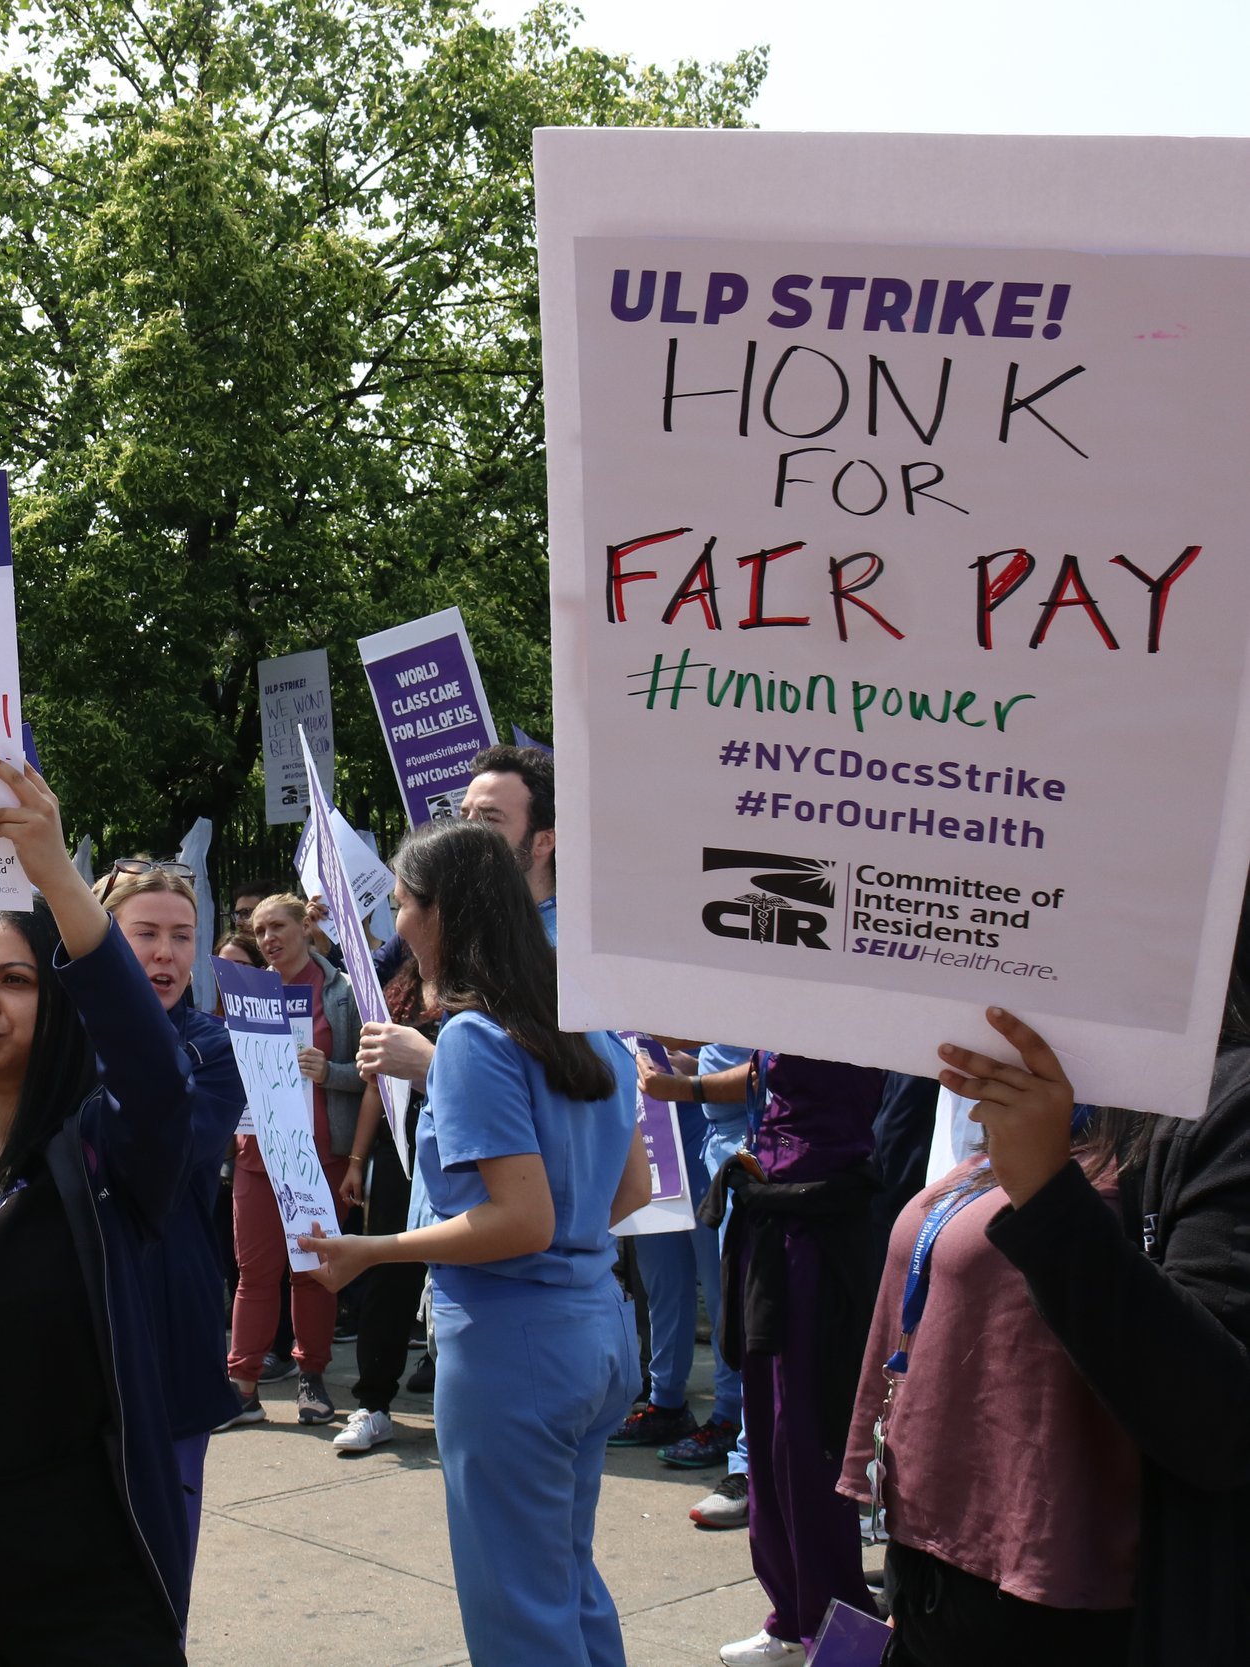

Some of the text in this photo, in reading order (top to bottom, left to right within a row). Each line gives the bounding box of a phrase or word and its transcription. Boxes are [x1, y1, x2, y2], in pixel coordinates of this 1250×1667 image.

[610, 269, 1071, 340] ULP STRIKE!
[663, 338, 1088, 459] HONK
[775, 448, 970, 516] FOR
[606, 528, 1202, 654] FAIR PAY
[264, 678, 306, 695] ULP STRIKE!
[396, 662, 439, 688] WORLD
[266, 695, 289, 720] WE
[392, 681, 462, 716] CLASS CARE
[391, 704, 477, 743] FOR ALL OF US.
[405, 739, 481, 768] #QueensStrikeReady
[719, 740, 1066, 802] #NYCDocsStrike
[406, 760, 471, 789] #NYCDocsSt
[735, 790, 1044, 849] #ForOurHealth
[5, 855, 14, 864] of
[856, 865, 1064, 909] Committee of
[702, 900, 831, 951] CIR
[855, 888, 1029, 929] Interns and
[853, 912, 999, 948] Residents
[224, 993, 242, 1017] ULP
[243, 996, 284, 1021] STRIKE!
[912, 1221, 934, 1275] Elmhurst
